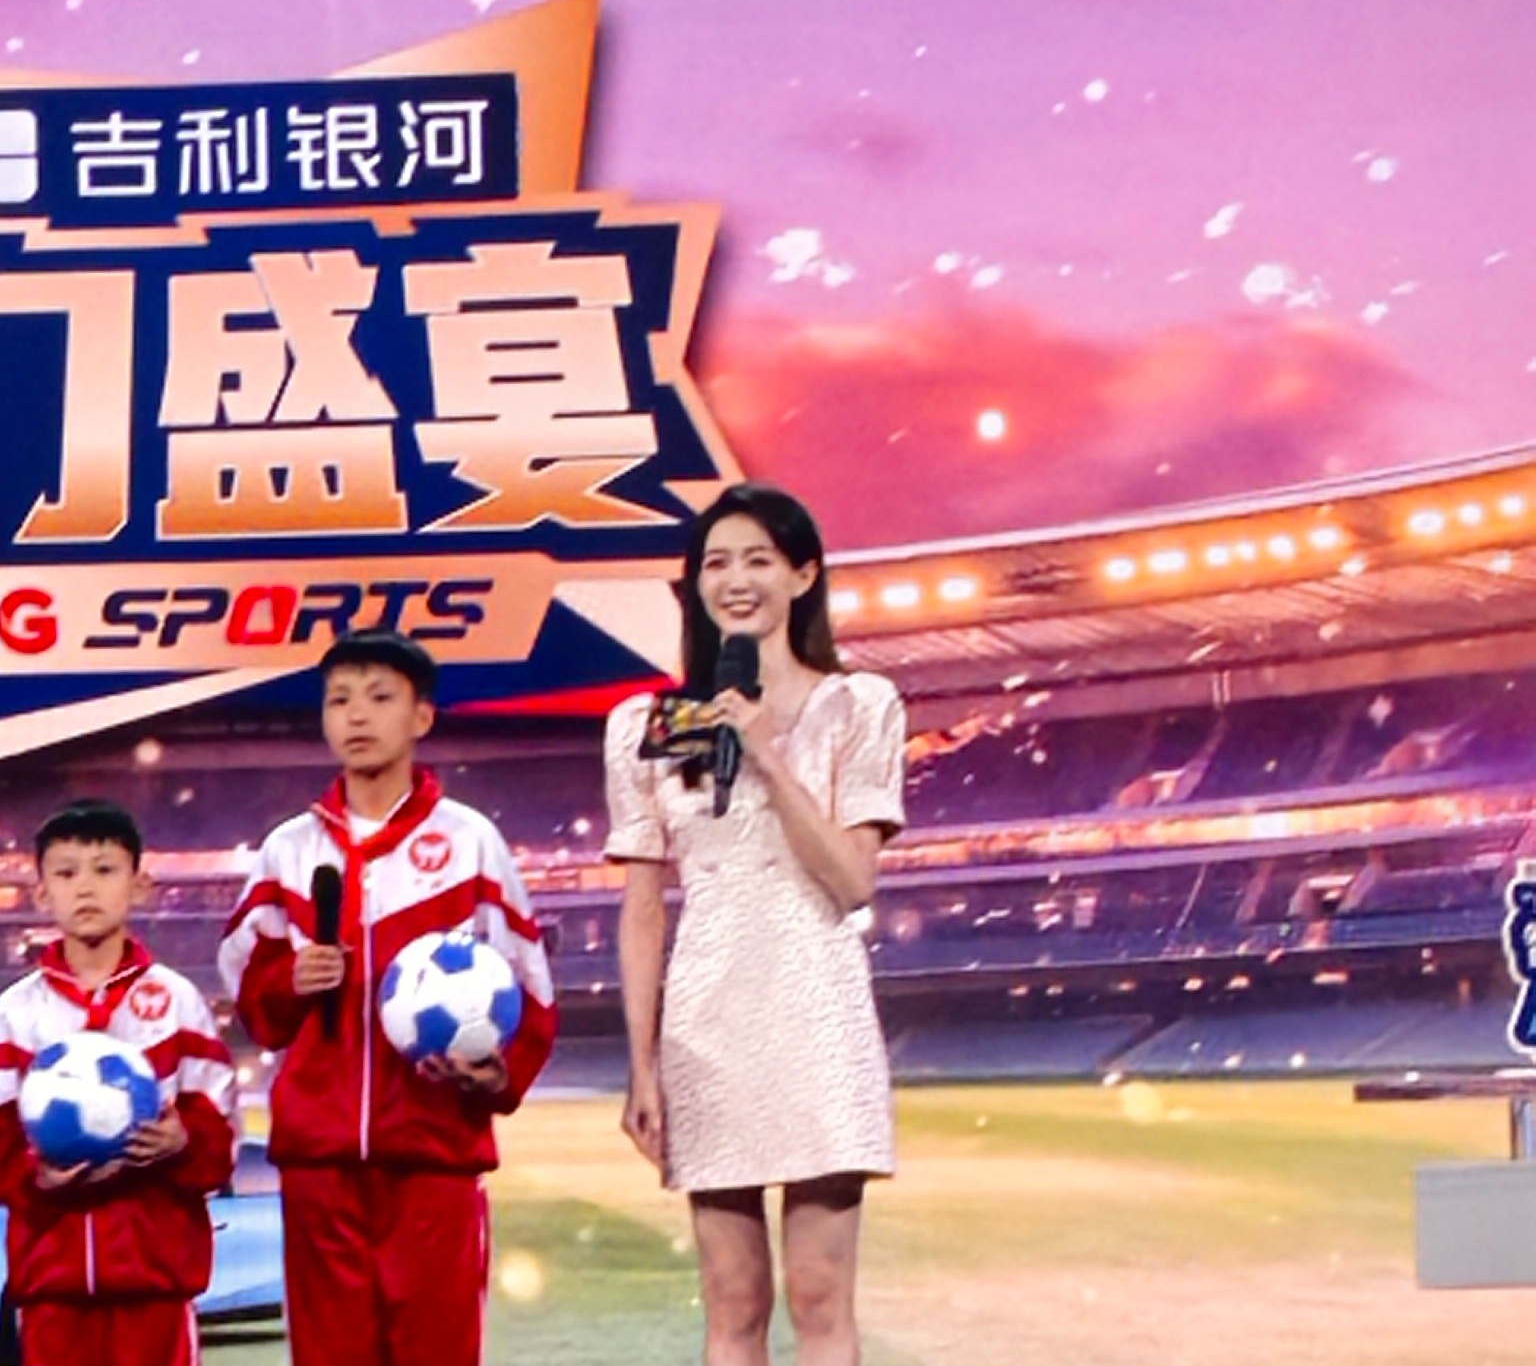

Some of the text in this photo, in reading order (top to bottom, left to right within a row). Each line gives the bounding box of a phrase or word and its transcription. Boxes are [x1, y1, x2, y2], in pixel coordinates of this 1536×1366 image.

[69, 100, 489, 198] 吉利银河
[82, 578, 494, 649] SPORTS
